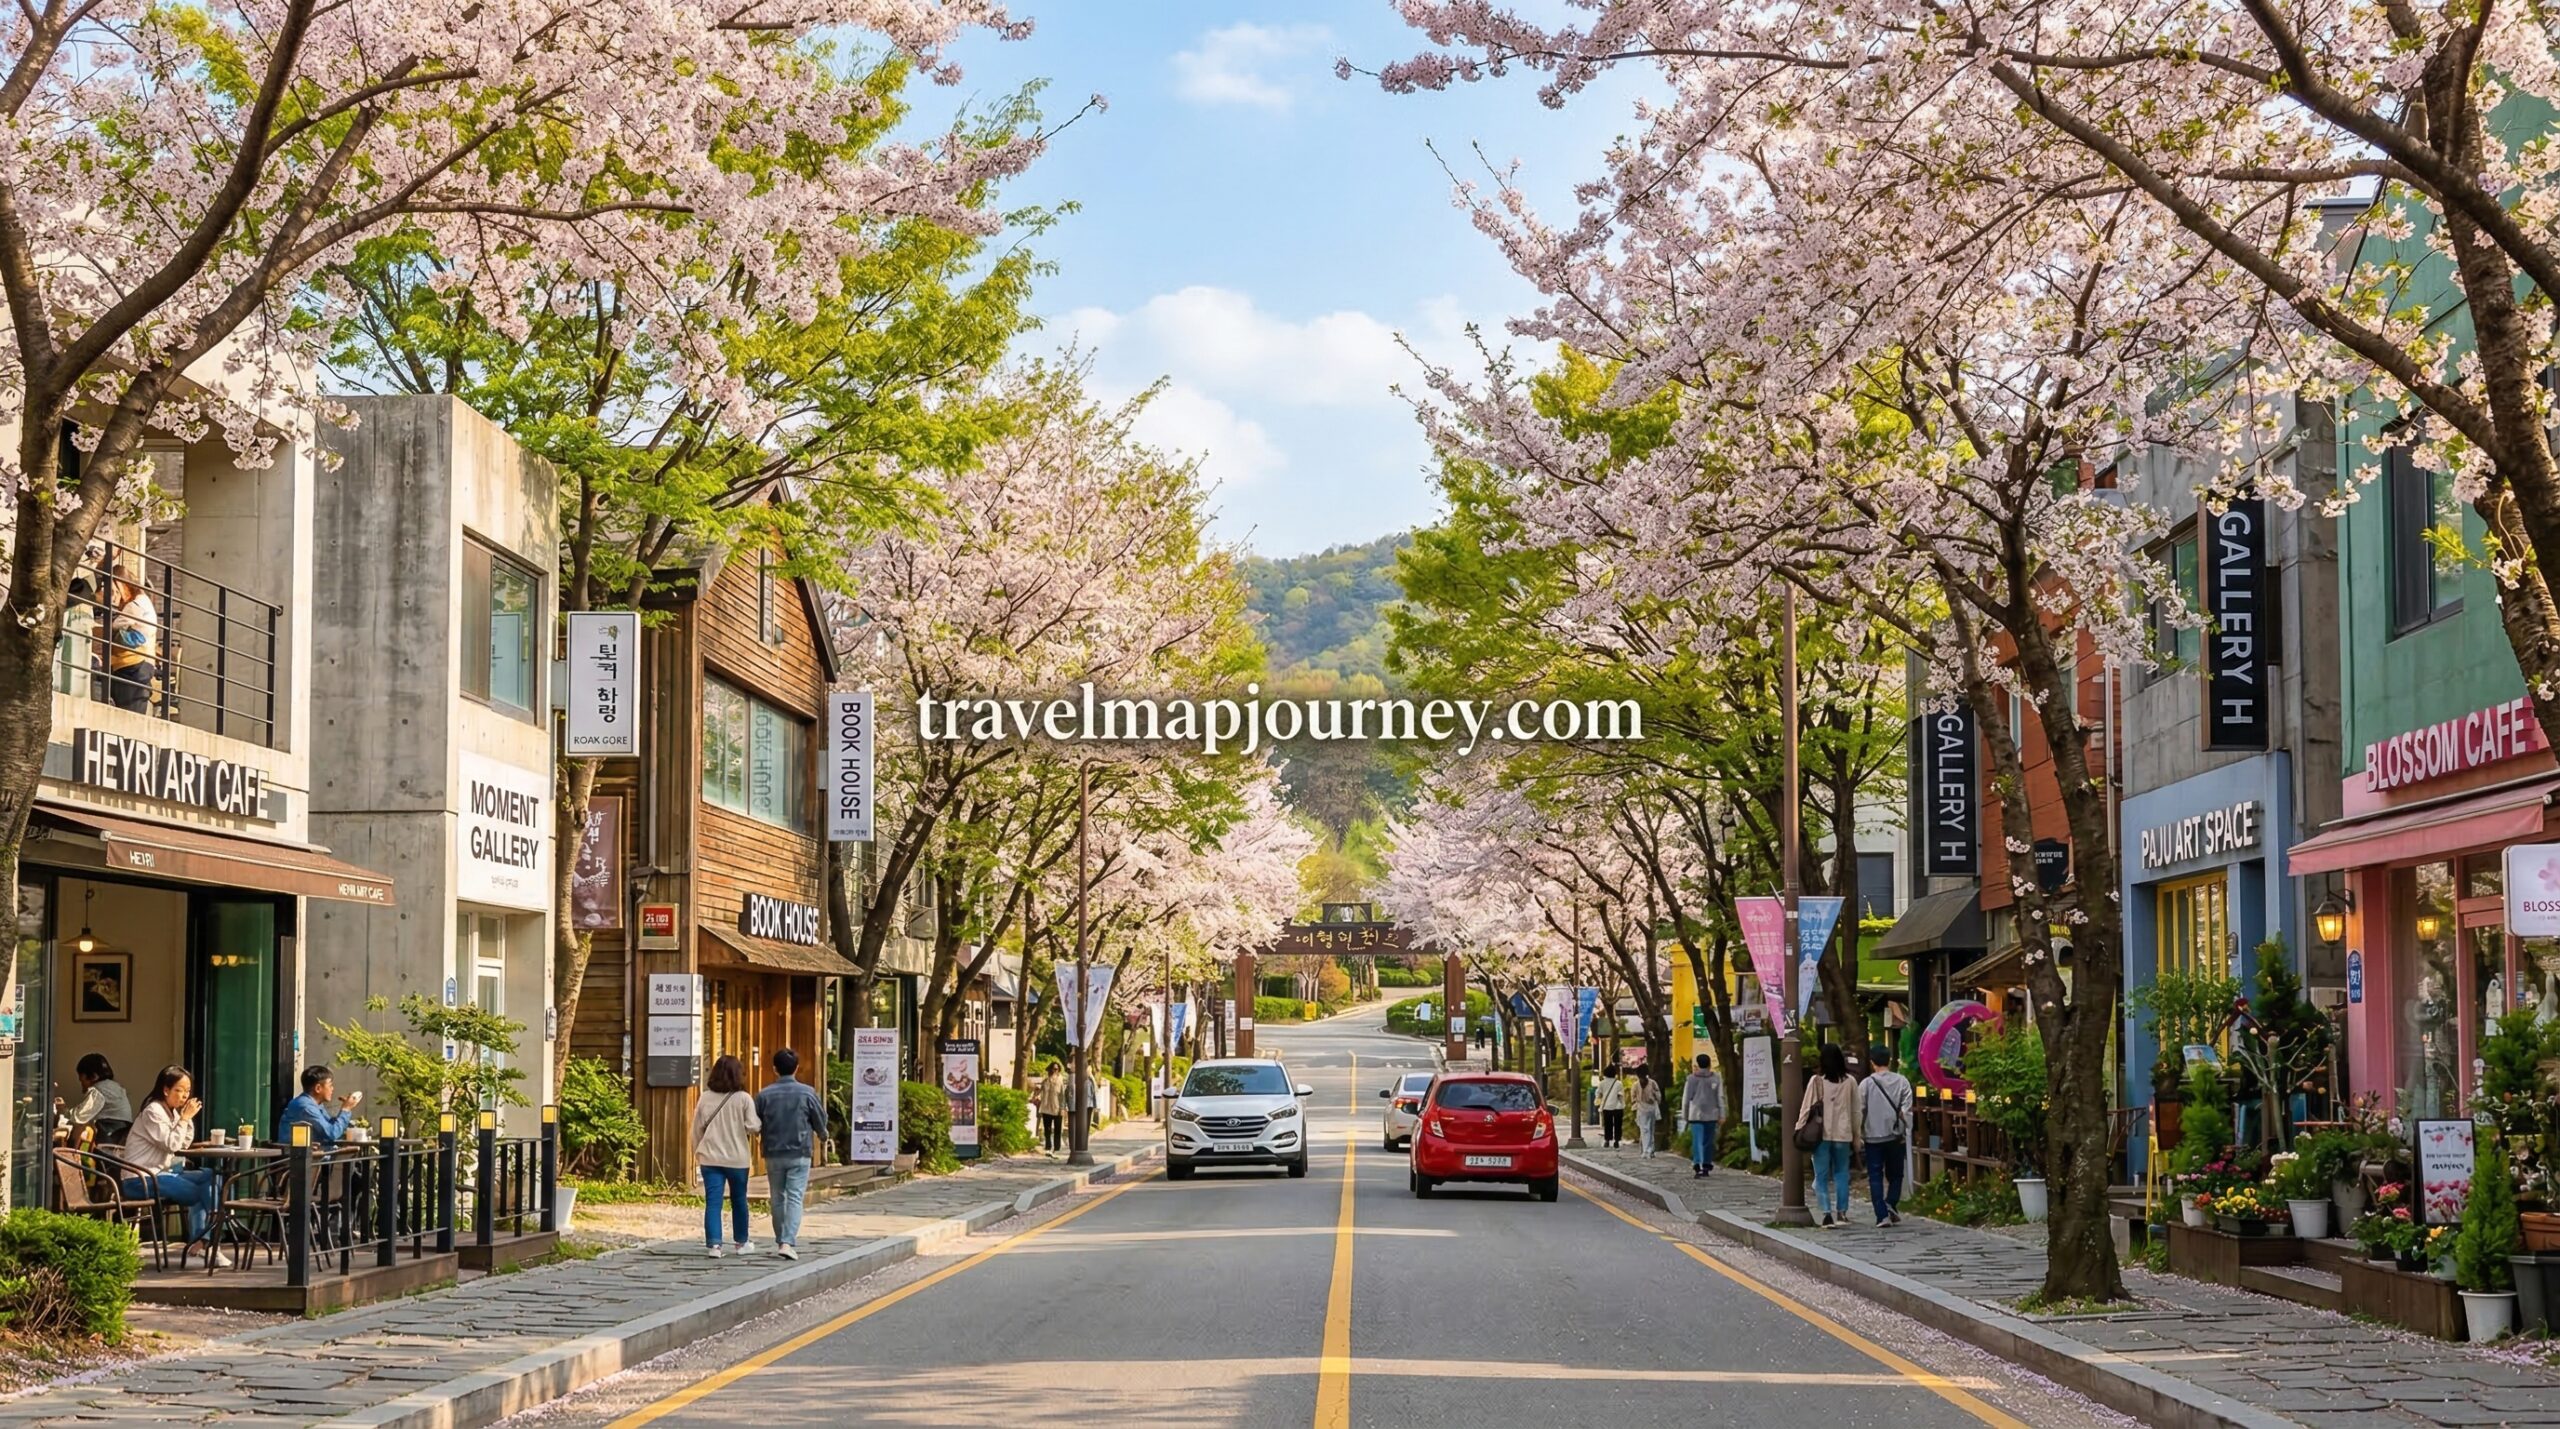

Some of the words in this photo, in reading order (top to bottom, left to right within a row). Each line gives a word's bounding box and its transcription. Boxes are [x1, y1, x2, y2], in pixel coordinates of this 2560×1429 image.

[2218, 511, 2253, 685] GALLERY
[841, 702, 861, 752] BOOK
[2221, 699, 2253, 725] H
[574, 736, 600, 745] ROAK
[602, 736, 628, 745] GORE
[2366, 718, 2459, 793] BLOSSOM
[2465, 697, 2526, 767] CAFE
[84, 729, 157, 797] HEYRI
[163, 747, 211, 807] ART
[214, 759, 269, 820] CAFE
[841, 758, 861, 820] HOUSE
[1937, 714, 1966, 832] GALLERY
[471, 780, 539, 829] MOMENT
[470, 826, 539, 870] GALLERY
[1940, 841, 1967, 861] H
[2141, 823, 2173, 870] PAJU
[2174, 815, 2202, 862] ART
[2204, 800, 2253, 855] SPACE
[751, 893, 783, 940] BOOK
[784, 901, 820, 945] HOUSE
